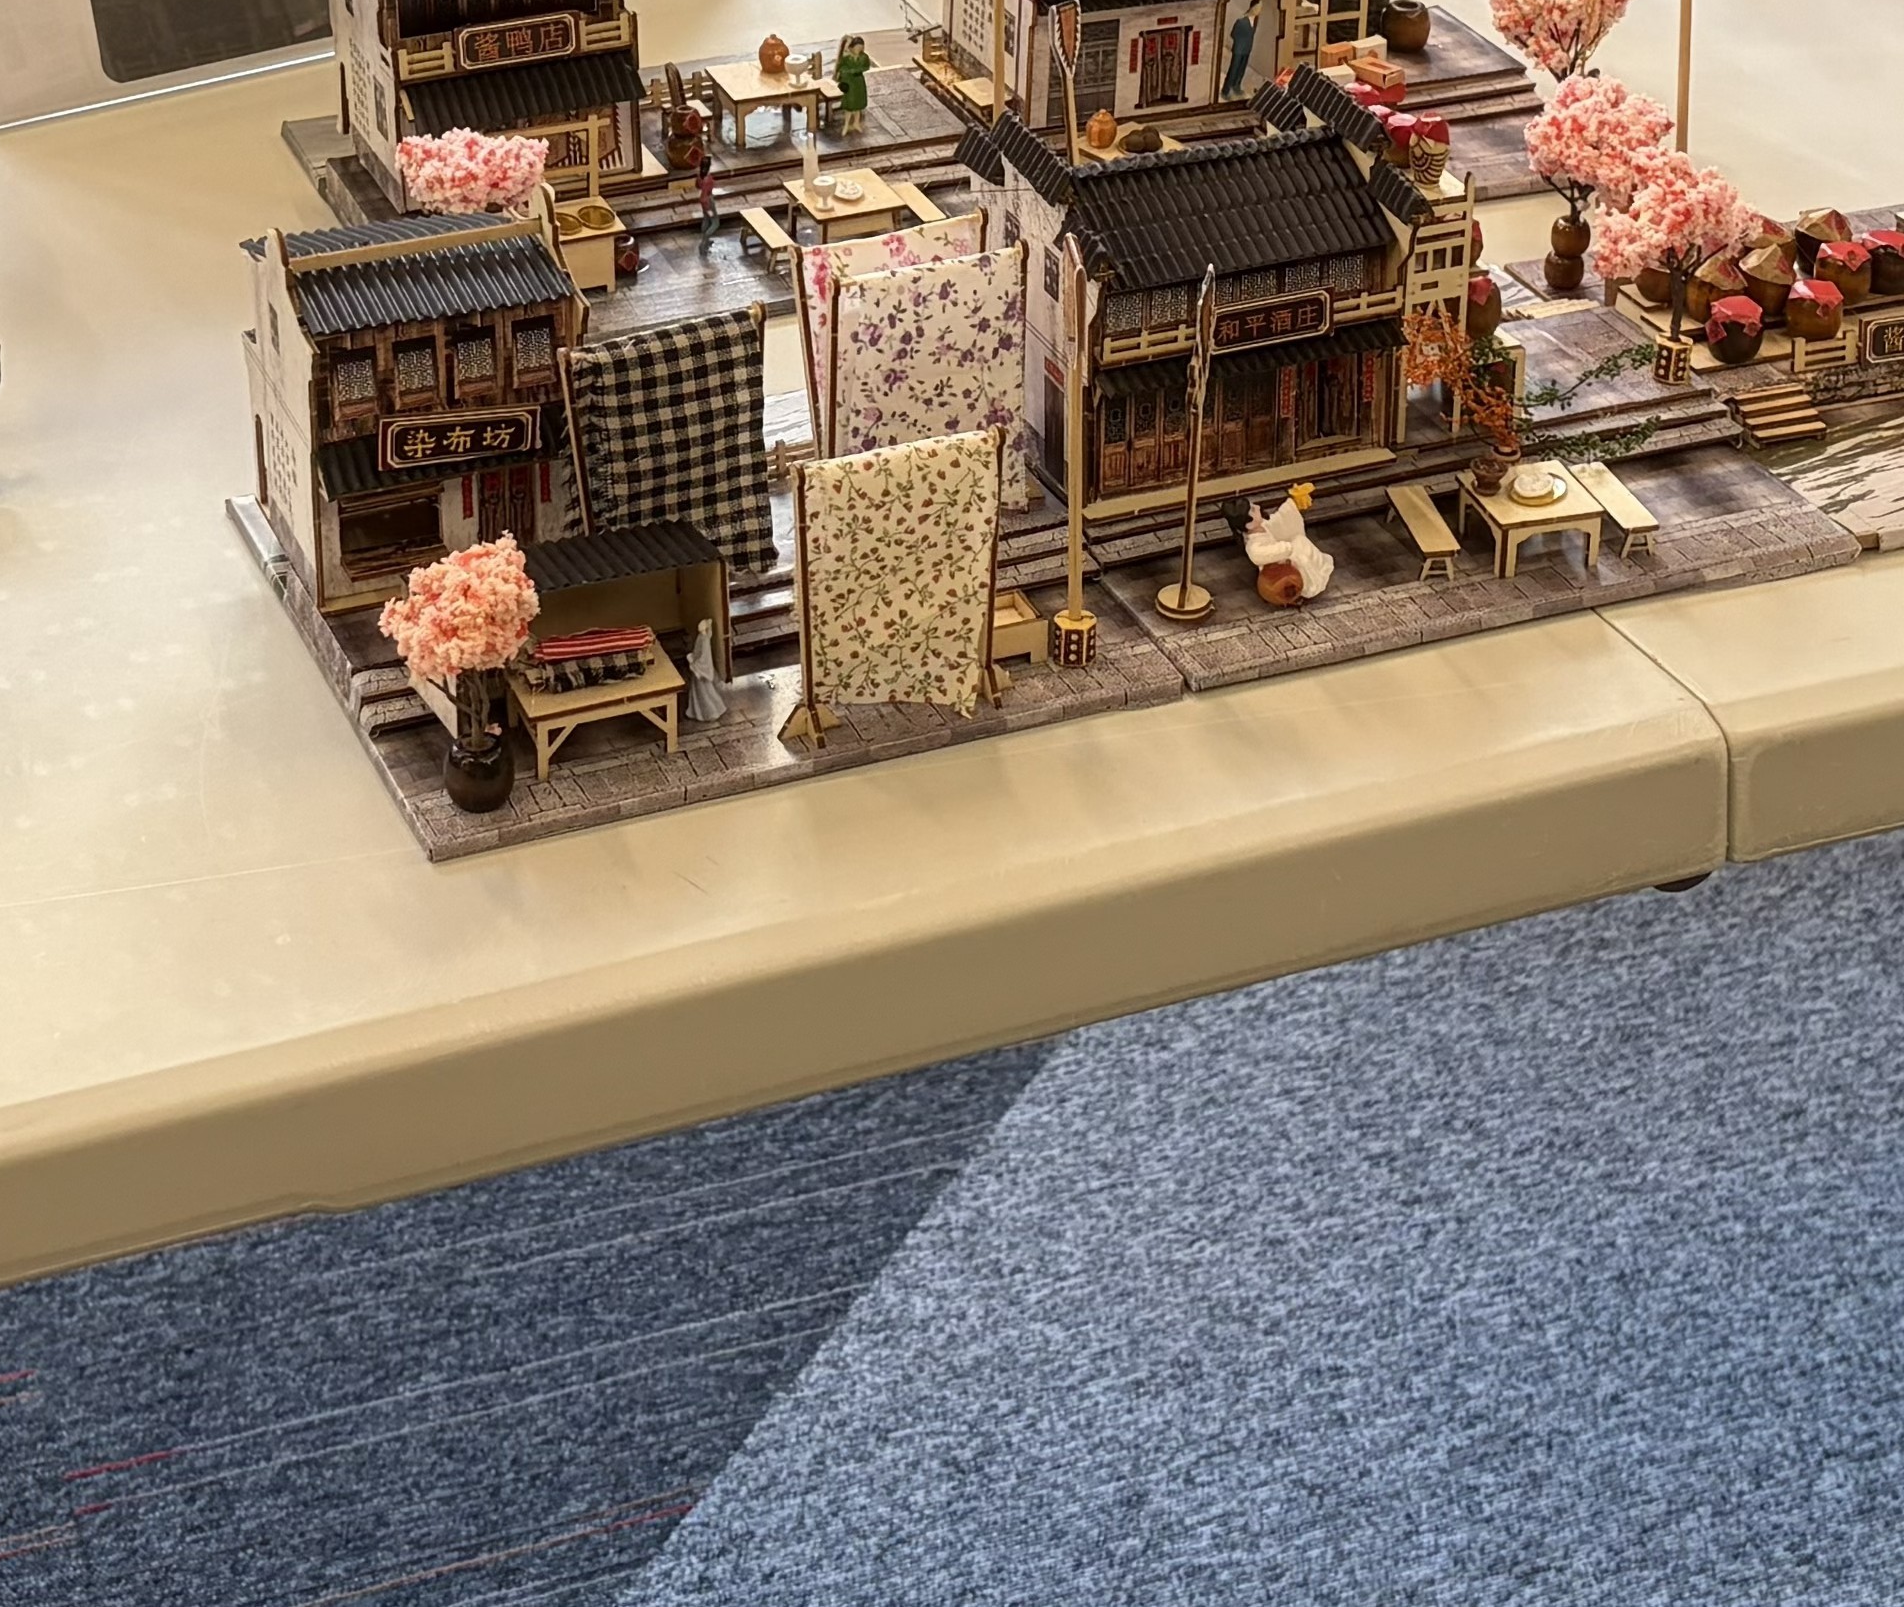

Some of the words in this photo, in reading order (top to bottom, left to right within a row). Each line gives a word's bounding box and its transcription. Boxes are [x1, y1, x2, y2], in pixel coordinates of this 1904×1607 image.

[1216, 304, 1320, 342] 和平酒庄
[403, 424, 517, 459] 染布坊
